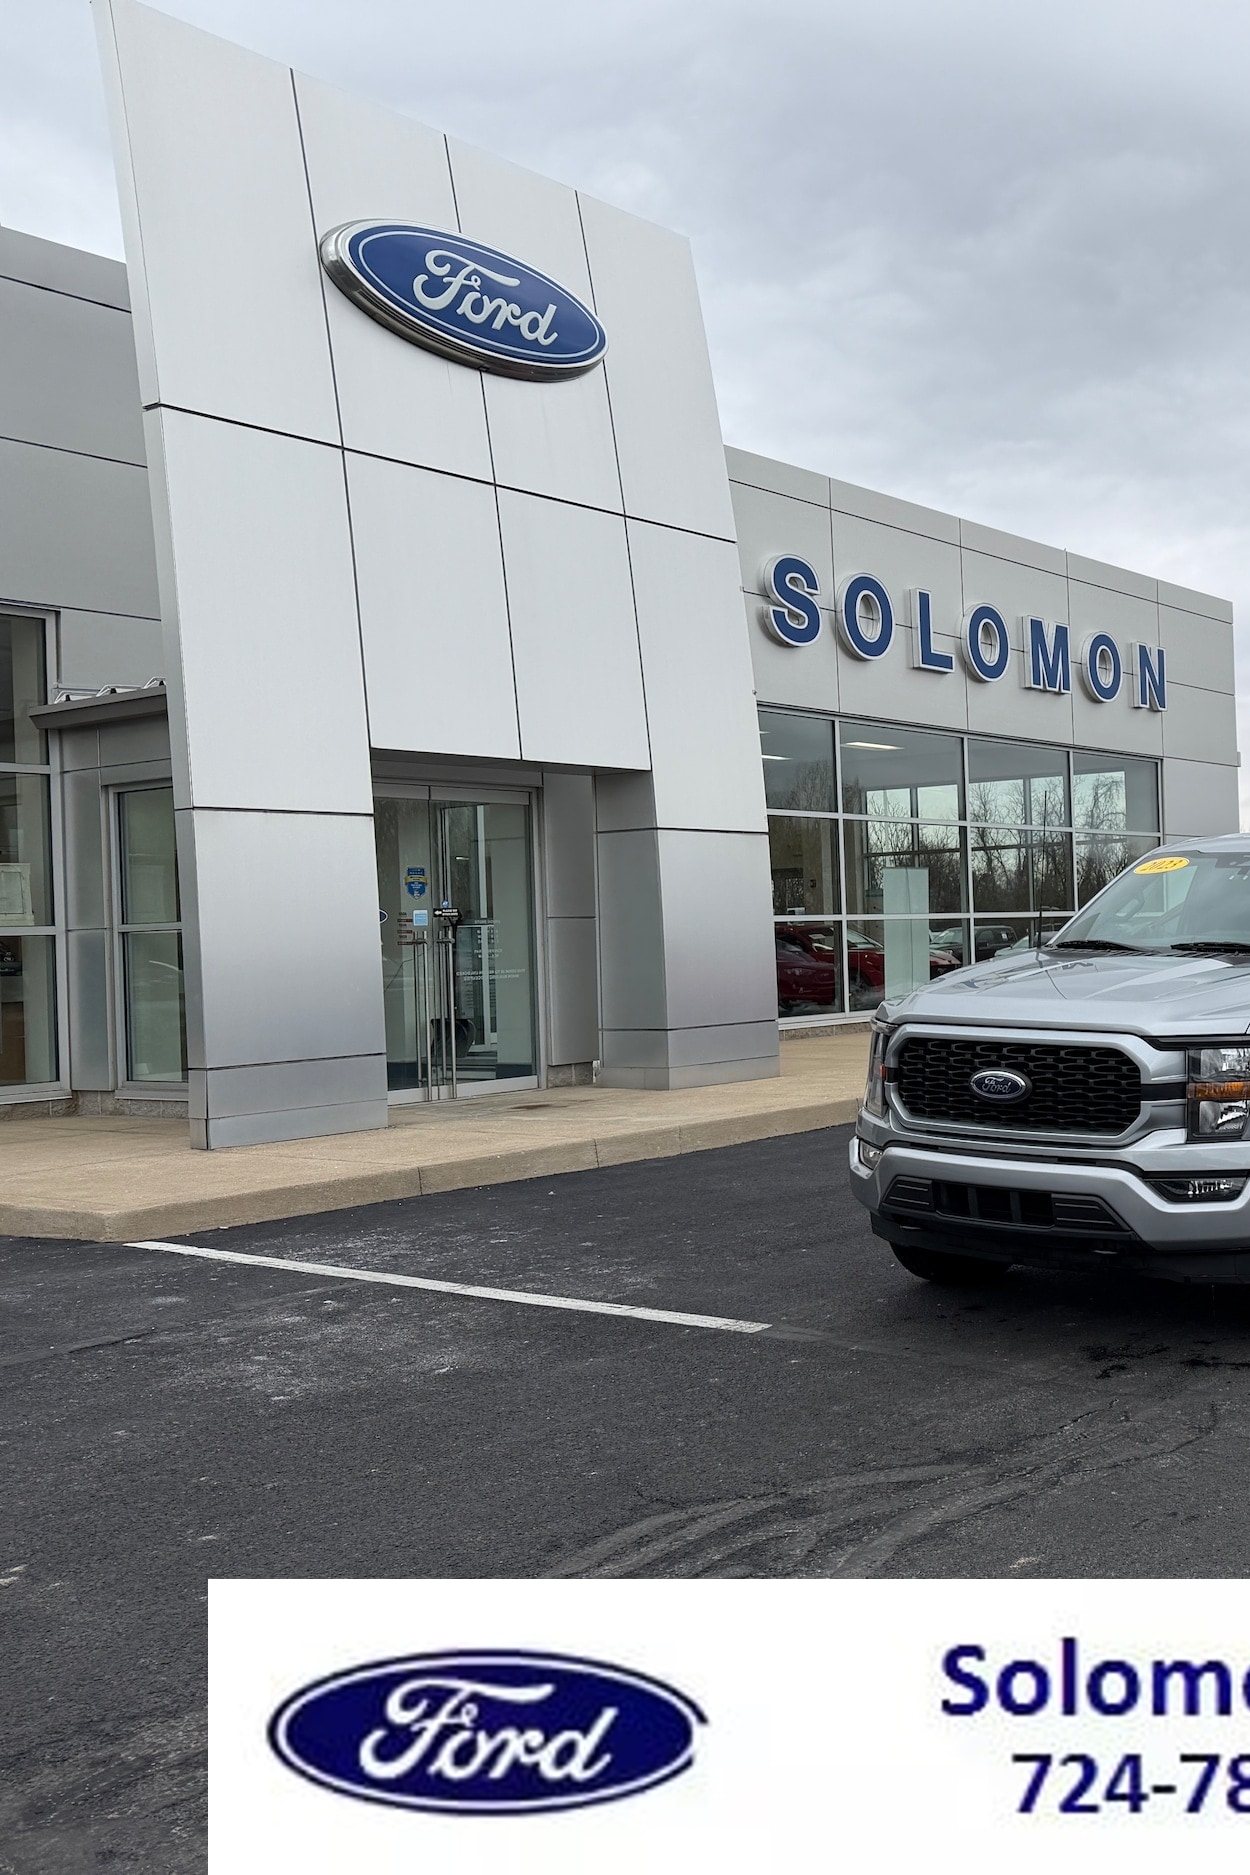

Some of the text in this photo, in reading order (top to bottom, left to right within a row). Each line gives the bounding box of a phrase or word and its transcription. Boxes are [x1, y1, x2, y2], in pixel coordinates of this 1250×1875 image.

[413, 249, 559, 347] Ford
[761, 553, 1168, 712] SOLOMON
[981, 1076, 1012, 1093] Ford
